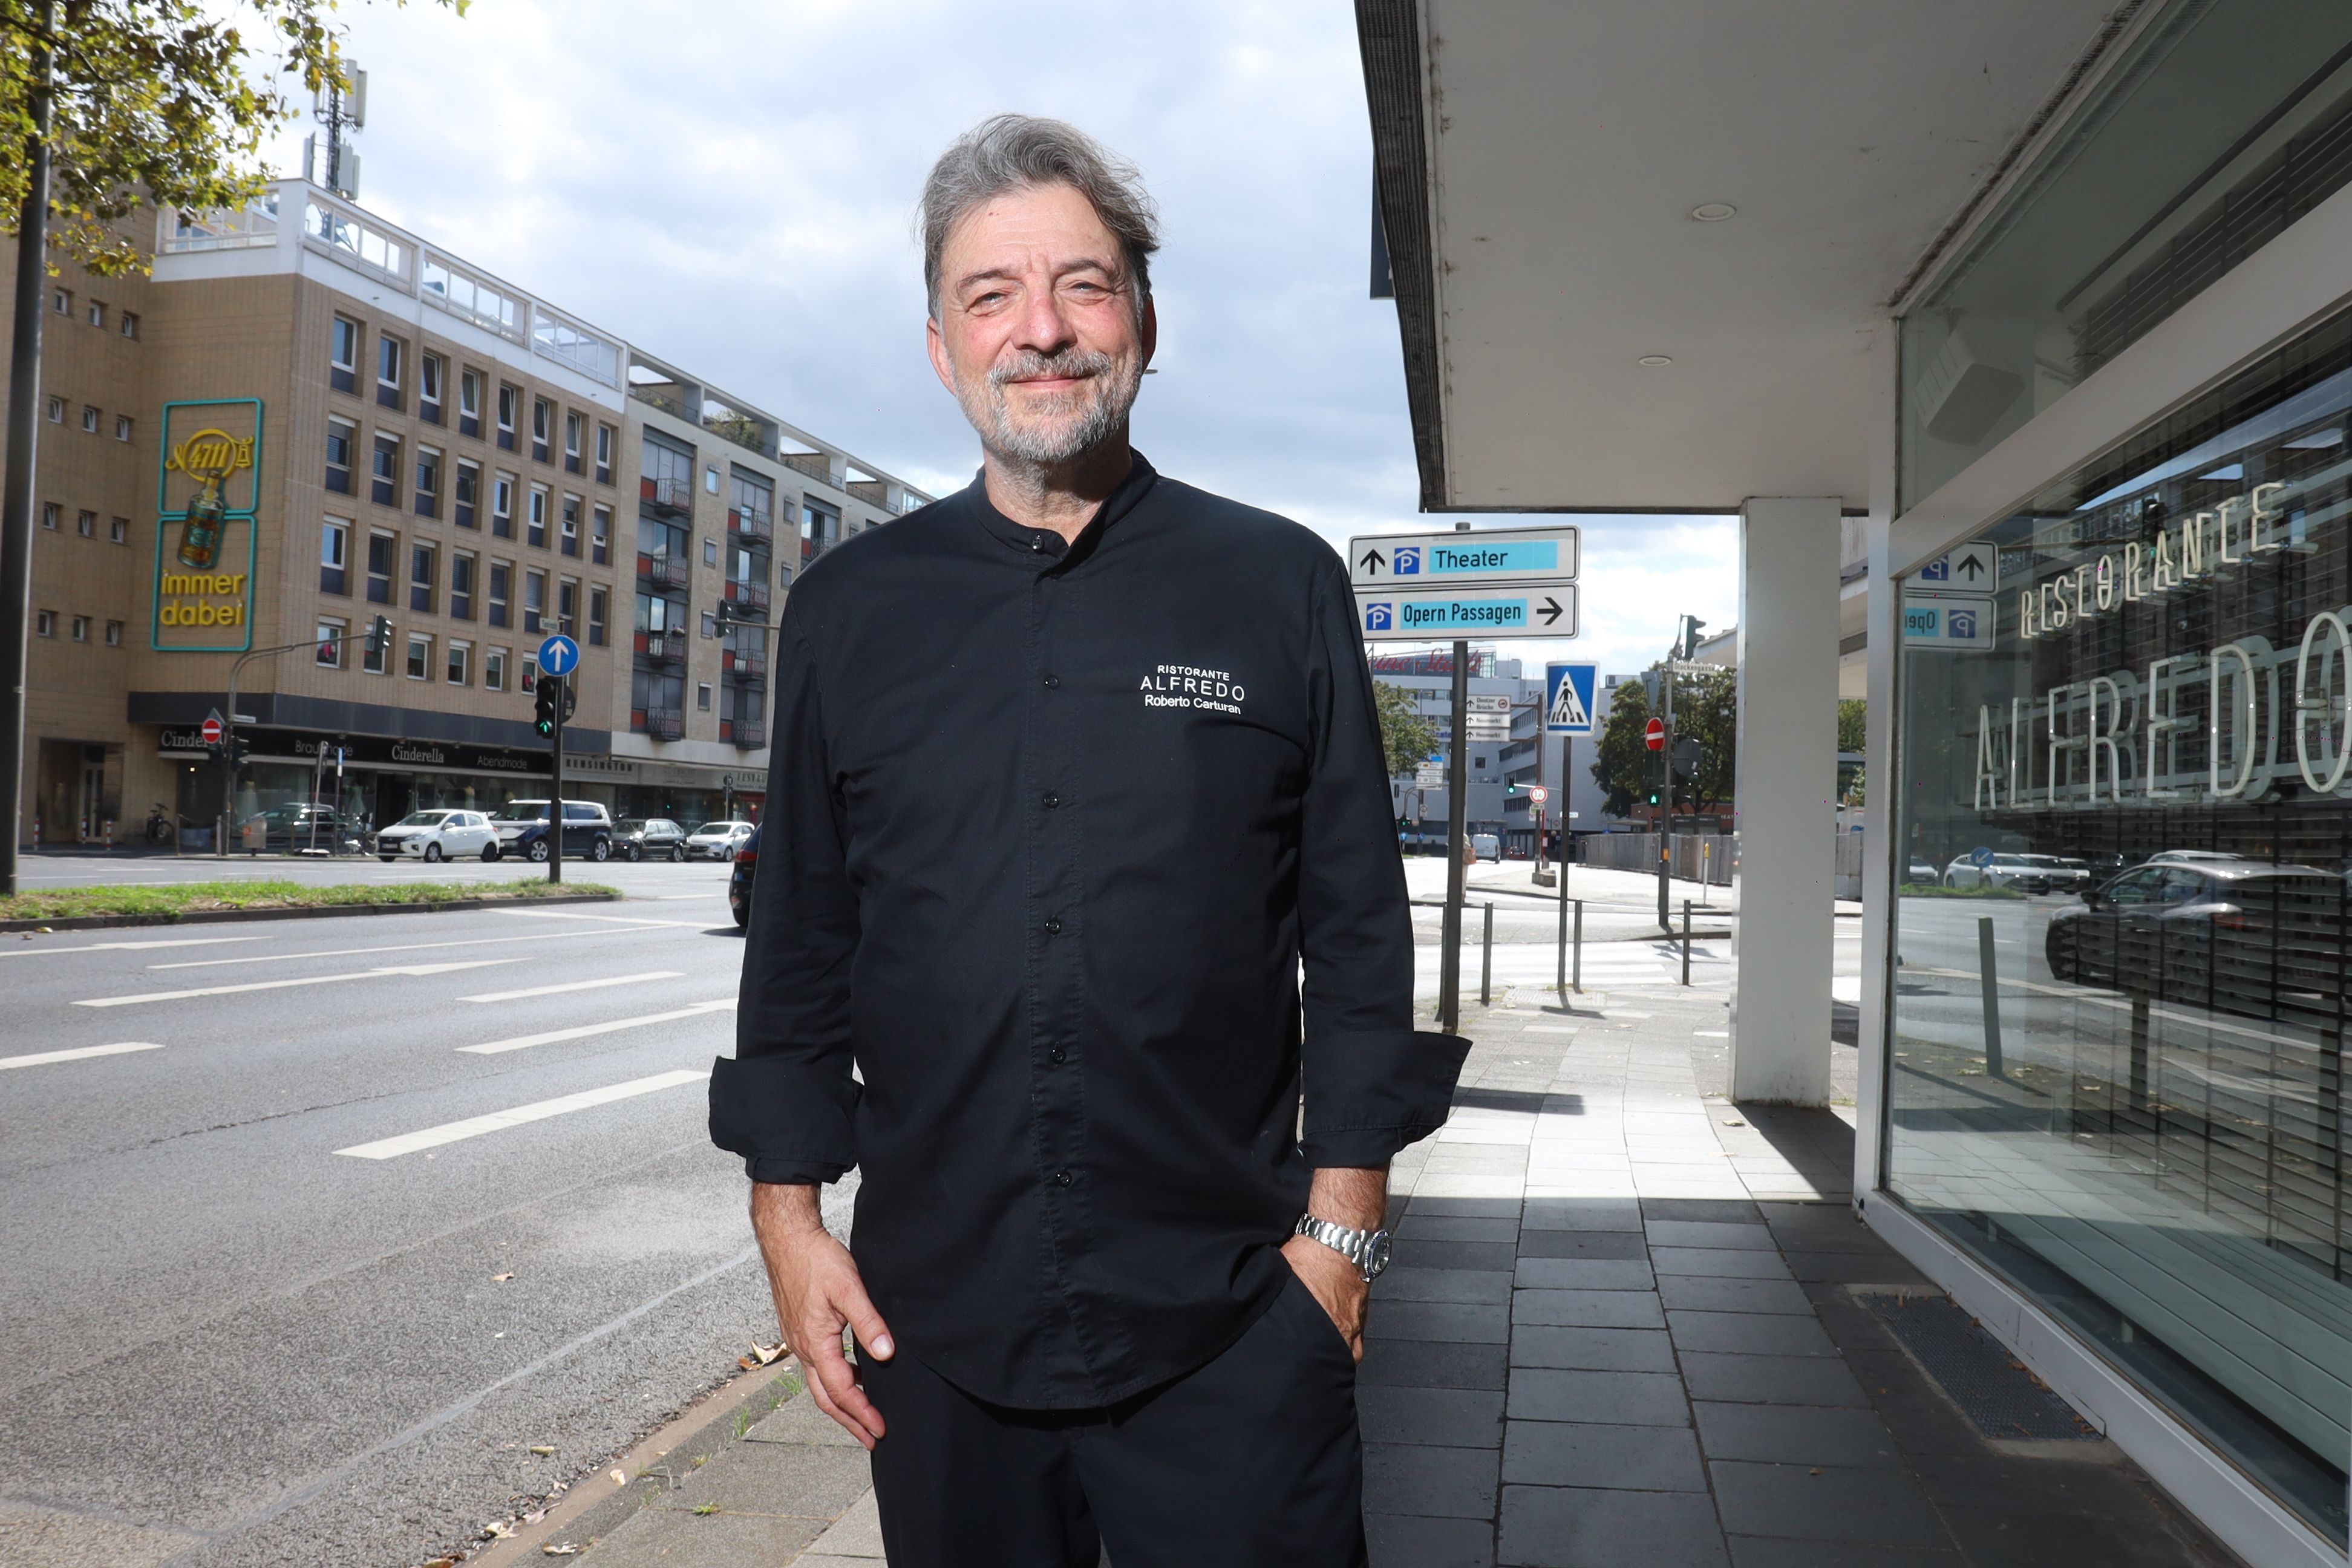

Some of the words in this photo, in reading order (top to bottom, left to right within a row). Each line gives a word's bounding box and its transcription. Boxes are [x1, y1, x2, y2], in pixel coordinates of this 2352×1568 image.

[1436, 549, 1508, 569] Theater
[162, 569, 247, 595] immer
[160, 599, 246, 626] dabei
[1403, 604, 1445, 627] Opern
[1452, 603, 1521, 625] Passagen
[1157, 665, 1230, 681] RISTORANTE
[1140, 675, 1245, 702] ALFREDO
[1145, 694, 1191, 707] Roberto
[1193, 697, 1241, 714] Carturan
[1975, 611, 2352, 812] ALFREDO
[392, 745, 445, 763] Cinderella
[477, 756, 528, 769] Abendmode
[566, 758, 633, 773] KENSINGTON
